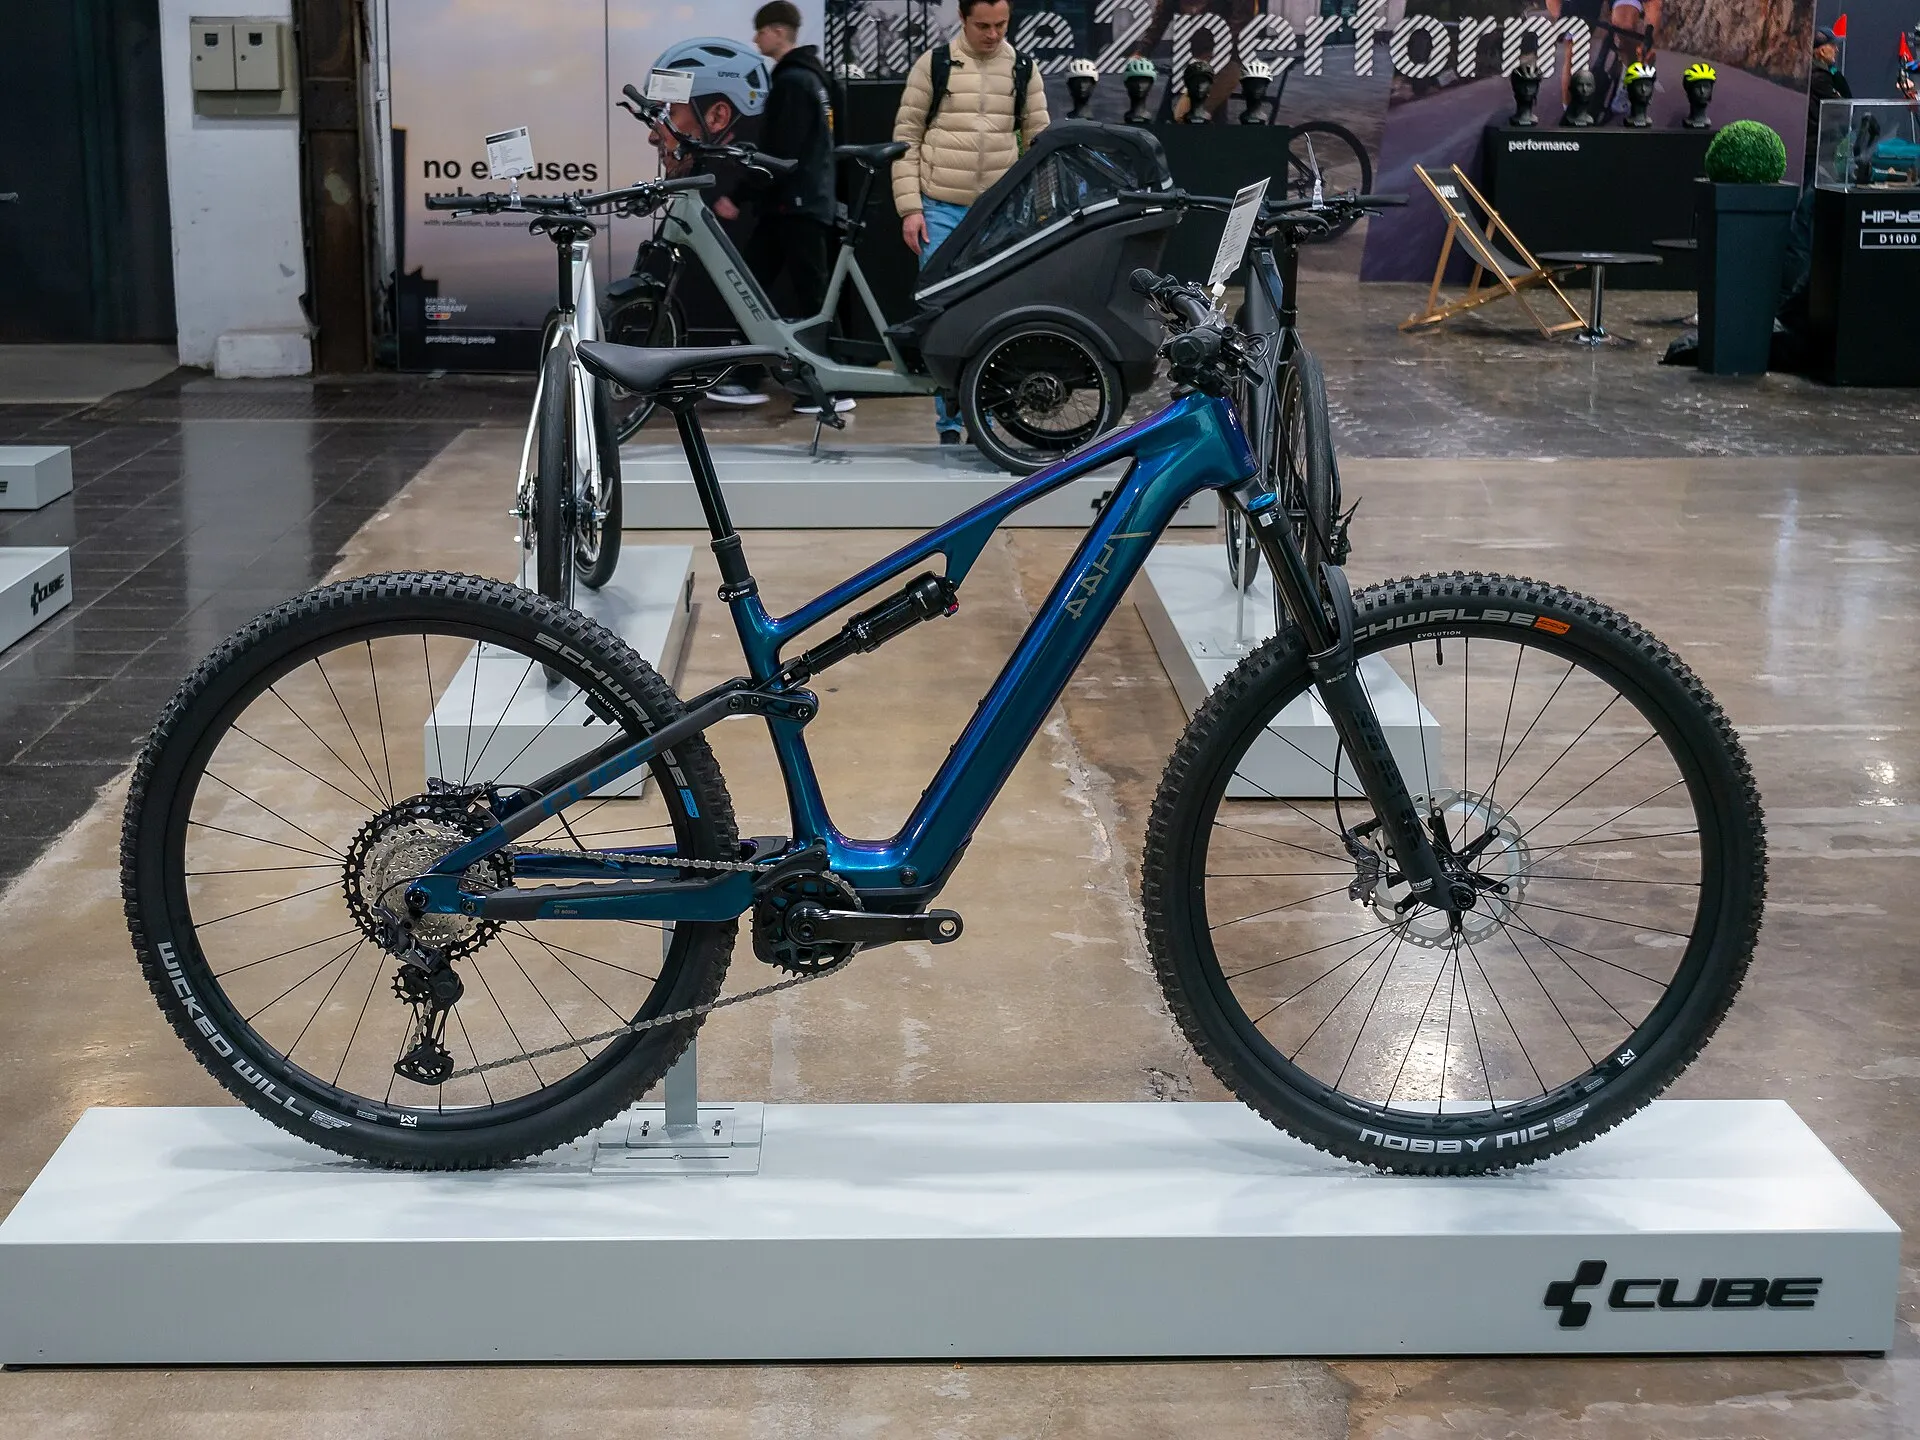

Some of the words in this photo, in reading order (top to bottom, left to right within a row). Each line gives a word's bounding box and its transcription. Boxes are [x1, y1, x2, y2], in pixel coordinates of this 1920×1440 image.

[1508, 139, 1580, 152] performance
[424, 159, 461, 179] no
[471, 160, 598, 182] euses
[1879, 233, 1917, 244] D1000
[425, 304, 467, 313] GERMANY
[724, 268, 766, 322] CUBE
[425, 335, 467, 345] protecting
[468, 335, 496, 345] people
[1354, 608, 1535, 642] HWALBE
[1417, 630, 1461, 639] EVOLUTION
[589, 687, 624, 721] EVOLUTION
[157, 941, 234, 1058] WICKED
[231, 1058, 304, 1117] WILL
[1358, 1127, 1487, 1154] NOBBY
[1496, 1121, 1550, 1149] NIC
[1607, 1277, 1824, 1311] CUBE
